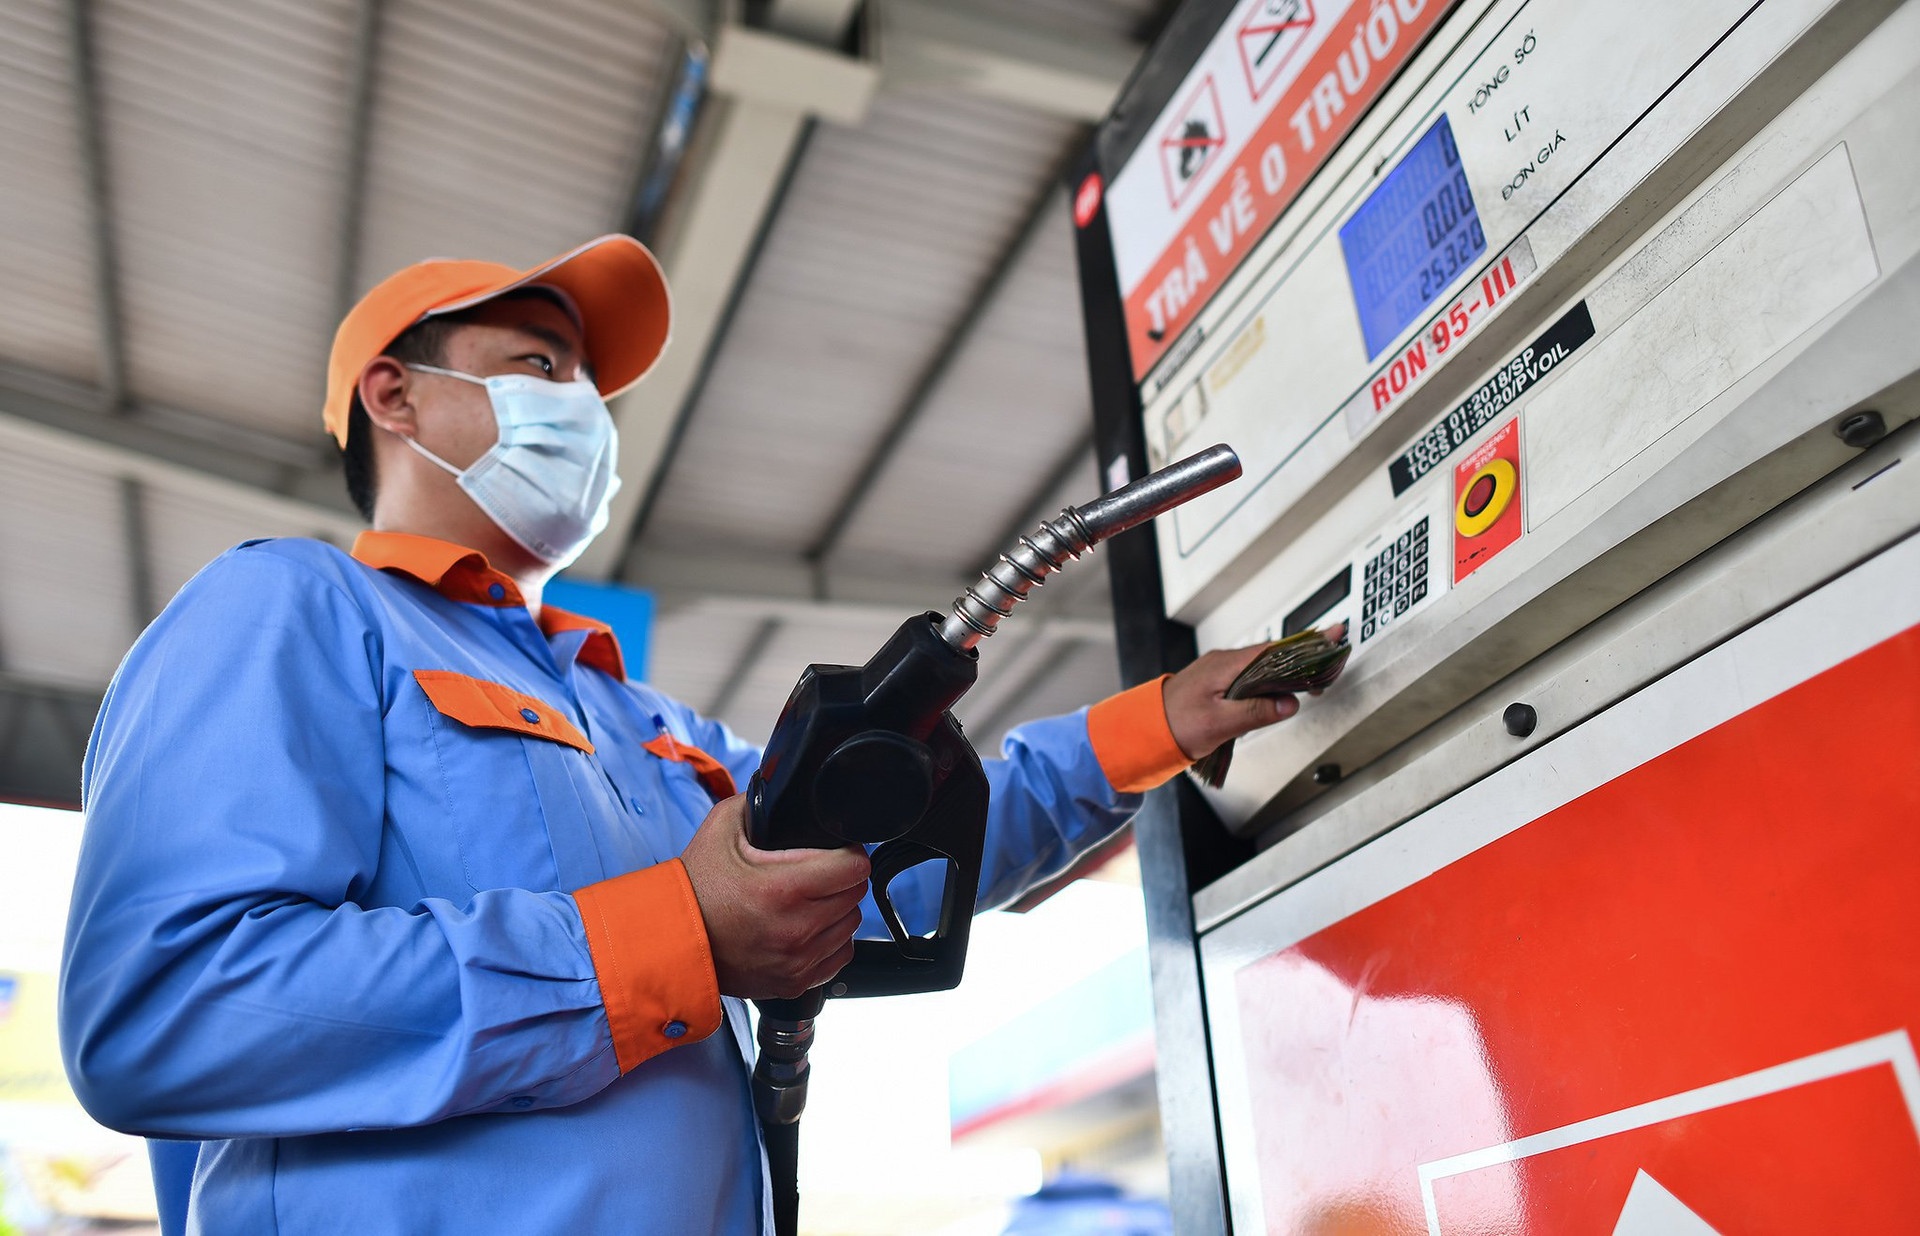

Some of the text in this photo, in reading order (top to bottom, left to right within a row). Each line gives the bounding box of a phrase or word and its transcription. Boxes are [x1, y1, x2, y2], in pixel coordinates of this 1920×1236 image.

[1514, 28, 1537, 65] SỐ
[1504, 104, 1530, 142] LÍT
[1502, 129, 1566, 201] ĐƠN GIÁ
[1145, 234, 1209, 333] TRẢ
[1209, 166, 1257, 256] VỀ
[1419, 217, 1486, 302] 25320
[1371, 256, 1517, 413] RON 95-III
[1405, 347, 1535, 466] TCCS 01:2018/SP
[1408, 343, 1570, 480] TCCS 01:2020/PVOIL
[1460, 425, 1512, 473] EMERGENCY
[1380, 609, 1390, 626] C
